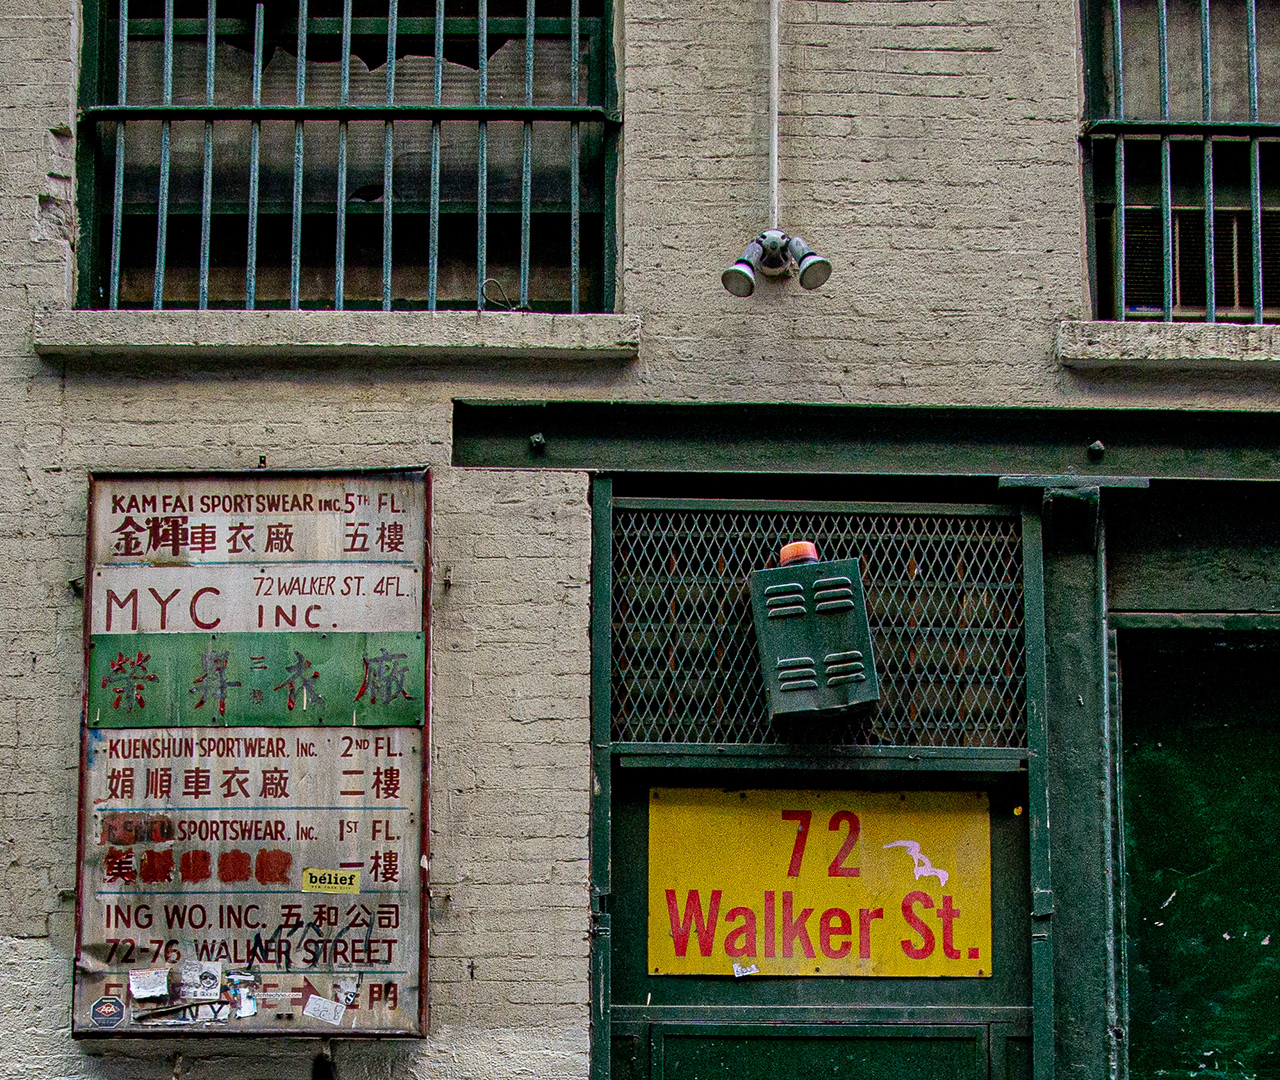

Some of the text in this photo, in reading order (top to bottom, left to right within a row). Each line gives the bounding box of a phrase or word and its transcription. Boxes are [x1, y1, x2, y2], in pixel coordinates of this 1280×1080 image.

[111, 494, 157, 514] KAM
[162, 494, 194, 513] FAI
[200, 493, 314, 513] SPORTSWEAR
[344, 492, 370, 514] 5TH
[378, 492, 406, 513] FL.
[110, 516, 405, 556] 金輝車衣廠 五樓
[105, 576, 410, 632] MYC 72 WALKER ST. 4FL.
[257, 604, 338, 629] INC.
[108, 737, 195, 760] KUENSHUN
[198, 737, 290, 759] SPORTWEAR,
[340, 735, 370, 758] 2ND
[374, 736, 403, 758] FL.
[340, 766, 400, 800] 二樓
[177, 819, 292, 842] SPORTSWEAR,
[371, 819, 401, 841] FL.
[781, 809, 861, 878] 72
[308, 872, 356, 886] bélief
[105, 904, 268, 930] ING WO, INC.
[280, 903, 400, 930] 五和公司
[664, 889, 980, 960] Walker St.
[105, 939, 182, 964] 72-76
[193, 939, 293, 964] WALKER
[302, 938, 398, 964] STREET
